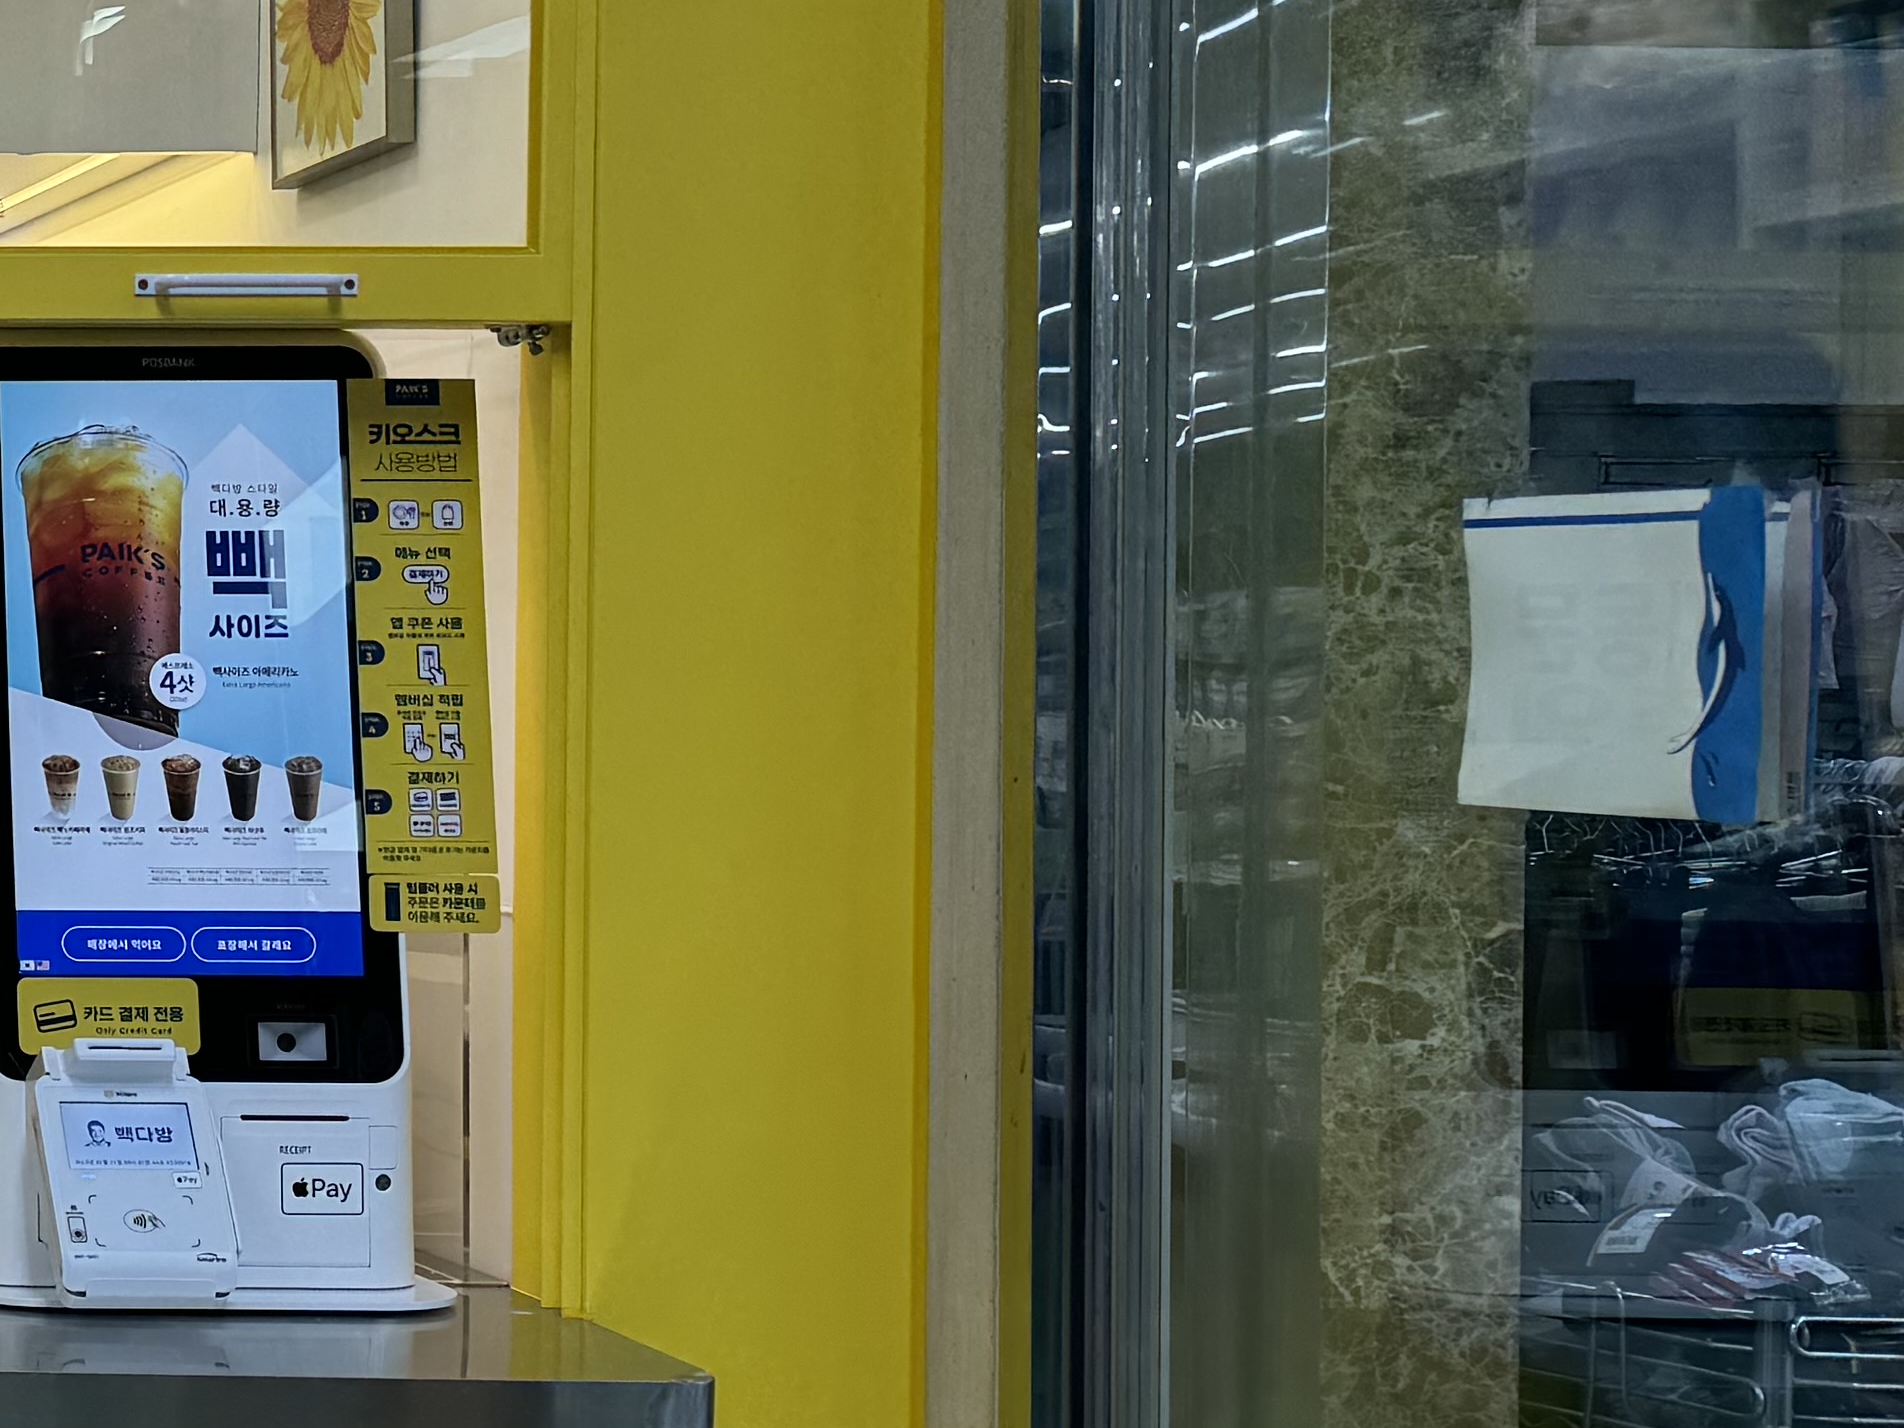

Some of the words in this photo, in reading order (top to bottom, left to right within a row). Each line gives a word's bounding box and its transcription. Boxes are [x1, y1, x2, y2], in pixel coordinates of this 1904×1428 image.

[369, 423, 461, 445] 키오스크
[375, 452, 457, 472] 사용방법
[361, 510, 366, 520] 1
[80, 542, 166, 571] PAIK'S
[426, 547, 451, 559] 선택
[205, 530, 287, 609] 빽
[361, 569, 369, 578] 2
[209, 615, 289, 639] 사이즈
[159, 670, 195, 694] 4샷
[373, 802, 381, 811] 5
[84, 1005, 114, 1022] 카드
[118, 1005, 148, 1023] 결제
[152, 1005, 184, 1022] 전용
[119, 1025, 148, 1035] Credit
[151, 1025, 172, 1035] Card
[279, 1145, 311, 1155] RECEIPT
[312, 1179, 352, 1201] Pay
